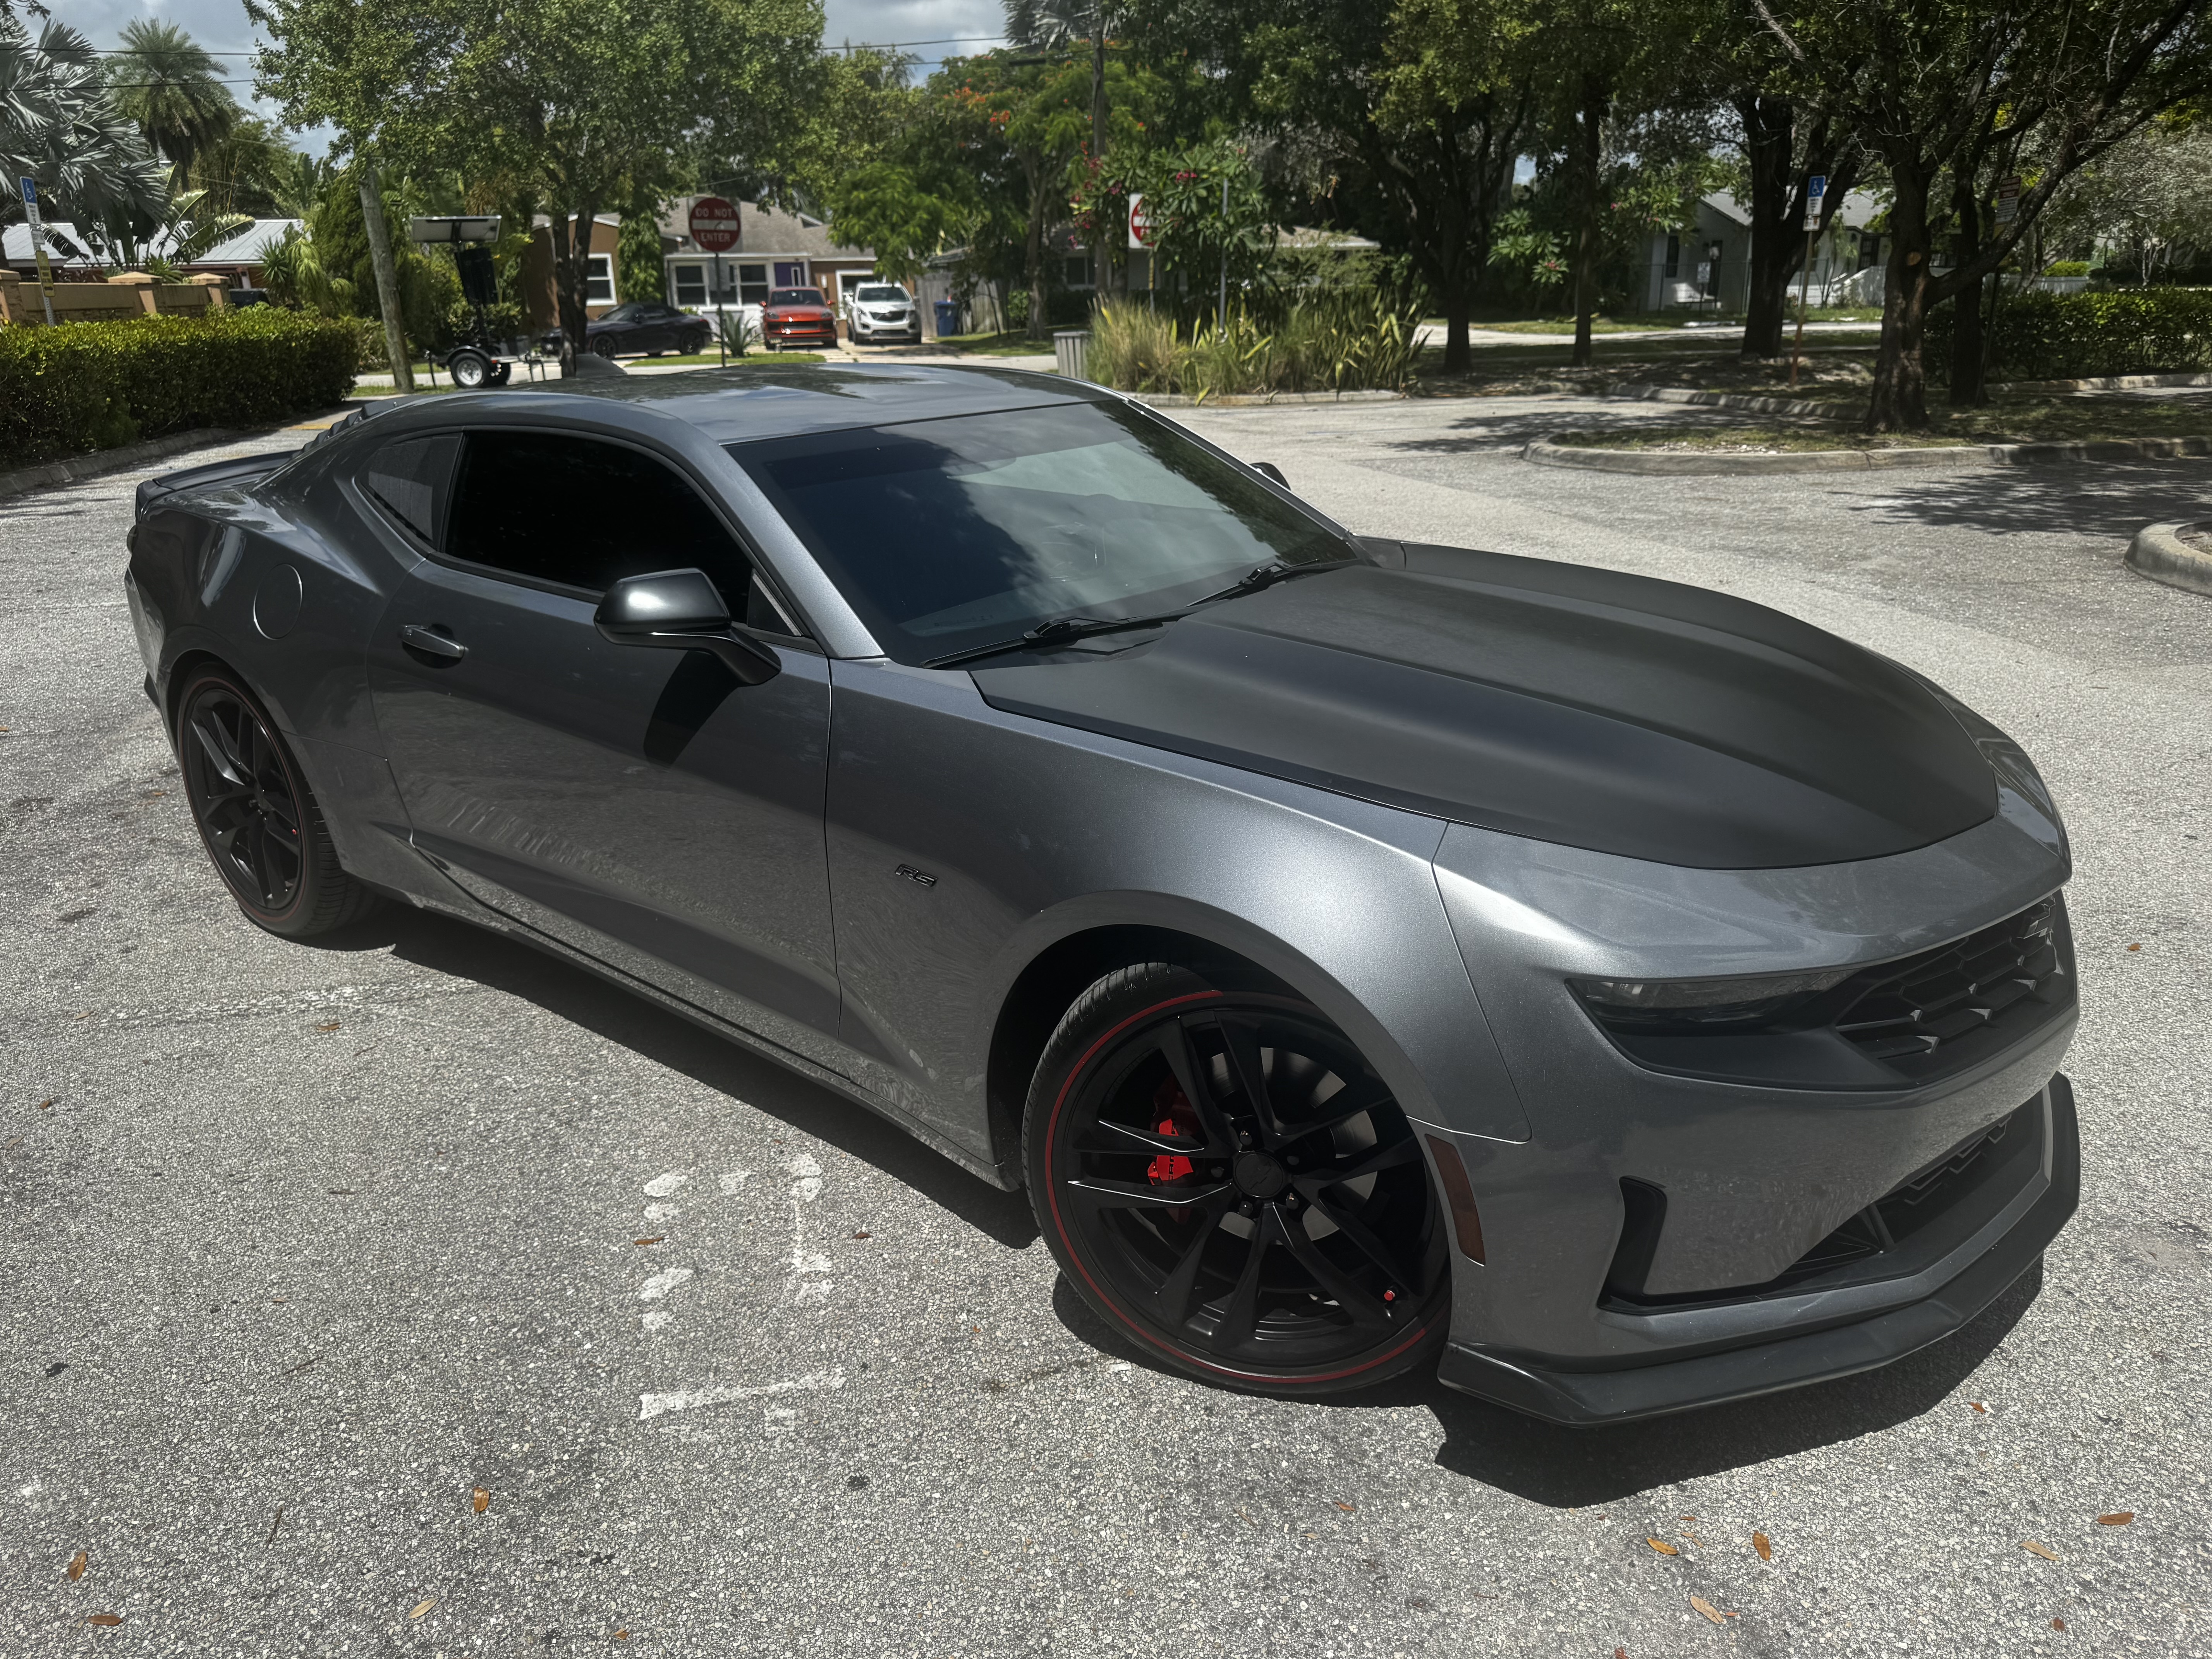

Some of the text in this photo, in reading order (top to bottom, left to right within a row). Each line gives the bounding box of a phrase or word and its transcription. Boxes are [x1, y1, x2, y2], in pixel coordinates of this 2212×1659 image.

[695, 208, 732, 218] DO NOT
[700, 233, 731, 242] ENTER
[895, 864, 938, 887] RS
